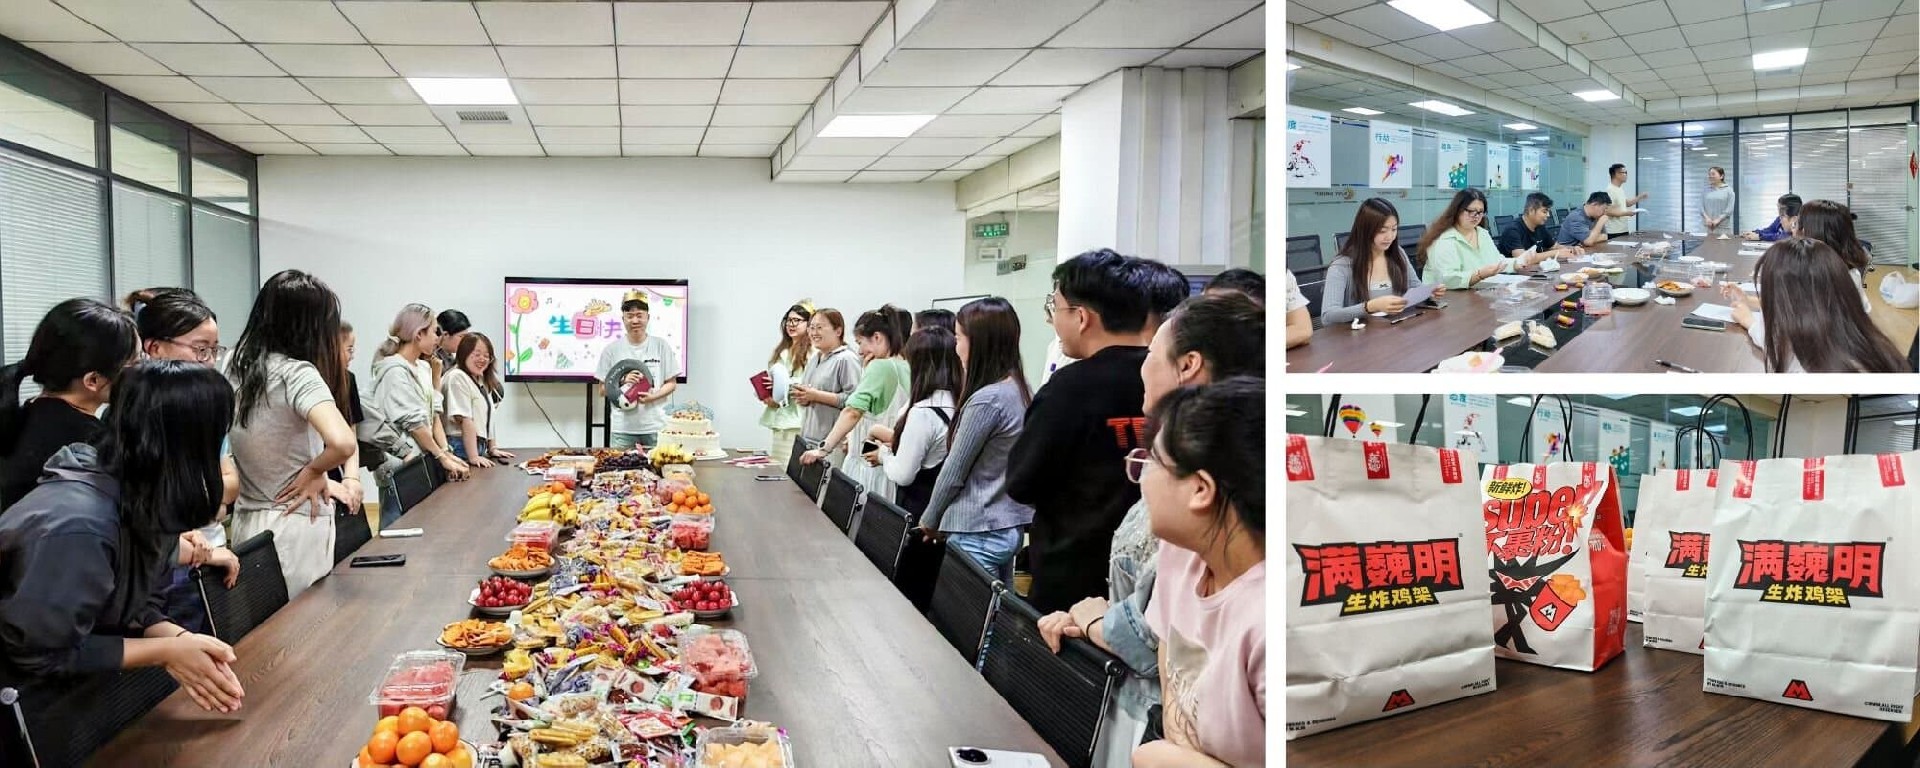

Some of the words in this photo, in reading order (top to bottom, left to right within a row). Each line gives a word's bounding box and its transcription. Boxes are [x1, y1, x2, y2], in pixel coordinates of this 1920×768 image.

[1487, 480, 1527, 495] 新鲜炸!
[1301, 542, 1460, 600] 满巍明
[1738, 542, 1881, 597] 满巍明
[1344, 586, 1434, 613] 生炸鸡架
[1765, 584, 1848, 605] 生炸鸡架
